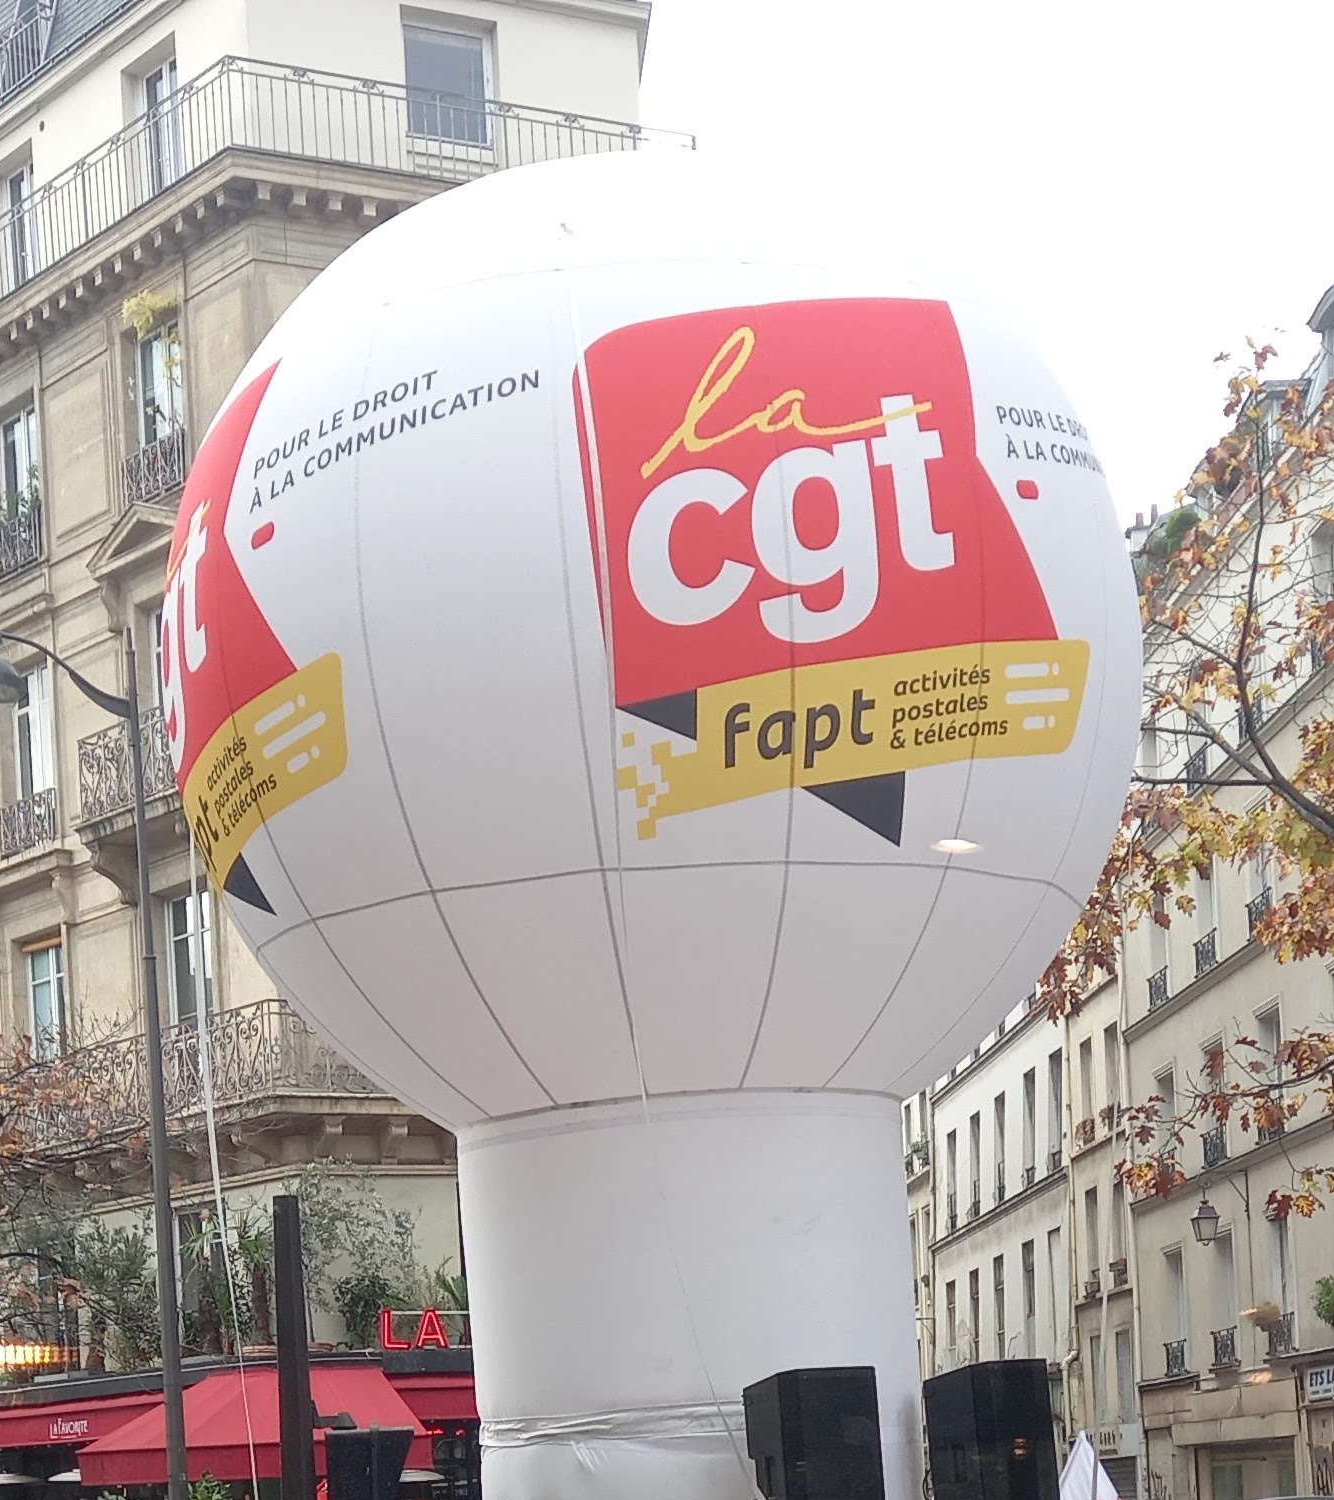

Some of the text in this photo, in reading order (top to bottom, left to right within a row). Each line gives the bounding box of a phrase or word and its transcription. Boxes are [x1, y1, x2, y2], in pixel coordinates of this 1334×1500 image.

[253, 369, 438, 480] POUR LE DROIT
[641, 326, 932, 479] la
[996, 405, 1047, 429] POUR
[1047, 412, 1067, 433] LE
[249, 369, 540, 514] À LA COMMUNICATION
[1005, 433, 1020, 459] À
[1023, 440, 1048, 461] LA
[626, 393, 956, 644] cgt
[893, 663, 991, 697] activités
[724, 688, 876, 769] fapt
[890, 719, 1009, 750] & télécoms
[891, 693, 989, 728] postales
[206, 735, 247, 792] activités
[213, 760, 254, 819] postales
[221, 773, 278, 837] & télécoms
[382, 1308, 449, 1351] LA
[1310, 1371, 1324, 1387] ETS
